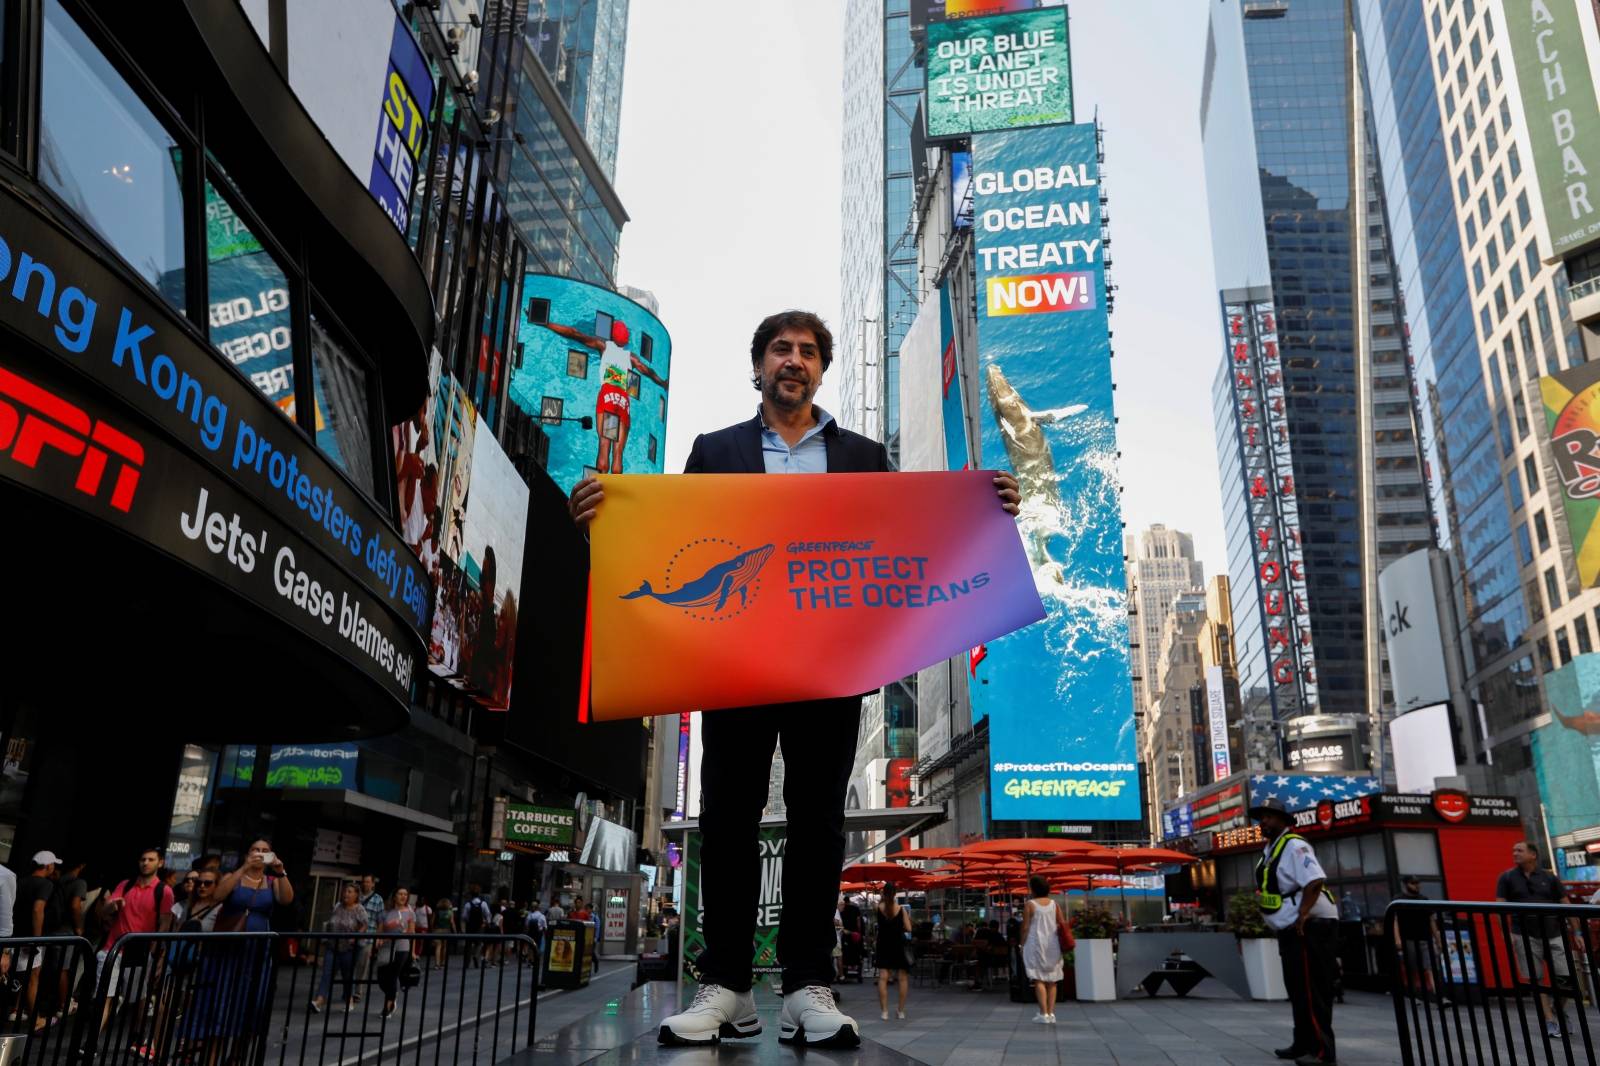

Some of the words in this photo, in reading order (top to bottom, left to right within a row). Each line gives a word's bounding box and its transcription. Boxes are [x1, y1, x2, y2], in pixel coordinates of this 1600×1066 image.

[937, 37, 987, 59] OUR
[993, 29, 1056, 52] BLUE
[949, 50, 1044, 76] PLANET
[937, 77, 969, 97] IS
[976, 67, 1059, 92] UNDER
[949, 87, 1046, 113] THREAT
[1551, 108, 1593, 220] BAR
[975, 164, 1097, 195] GLOBAL
[983, 201, 1090, 232] OCEAN
[978, 239, 1099, 271] TREATY
[993, 276, 1089, 309] NOW!
[0, 234, 97, 353] ng
[112, 306, 228, 451] Kong
[233, 420, 363, 556] protesters
[366, 533, 401, 598] defy
[0, 367, 145, 513] PN
[786, 539, 876, 554] GREENPEACE
[787, 556, 929, 584] PROTECT
[180, 488, 267, 573] Jets'
[274, 546, 334, 625] Gase
[339, 591, 395, 673] blames
[396, 652, 413, 692] self
[789, 585, 853, 610] THE
[861, 571, 991, 609] OCEANS
[1257, 528, 1294, 684] YOUNG
[993, 761, 1136, 773] #ProtectTheOceans
[1004, 778, 1126, 798] GREENPEACE
[1381, 795, 1431, 805] SOUTHEAST
[1472, 797, 1505, 807] TACOS
[1334, 797, 1371, 820] SHACK
[1393, 805, 1422, 815] ASIAN
[1470, 807, 1490, 816] HOT
[1492, 808, 1519, 818] DOGS
[513, 823, 560, 837] COFFEE
